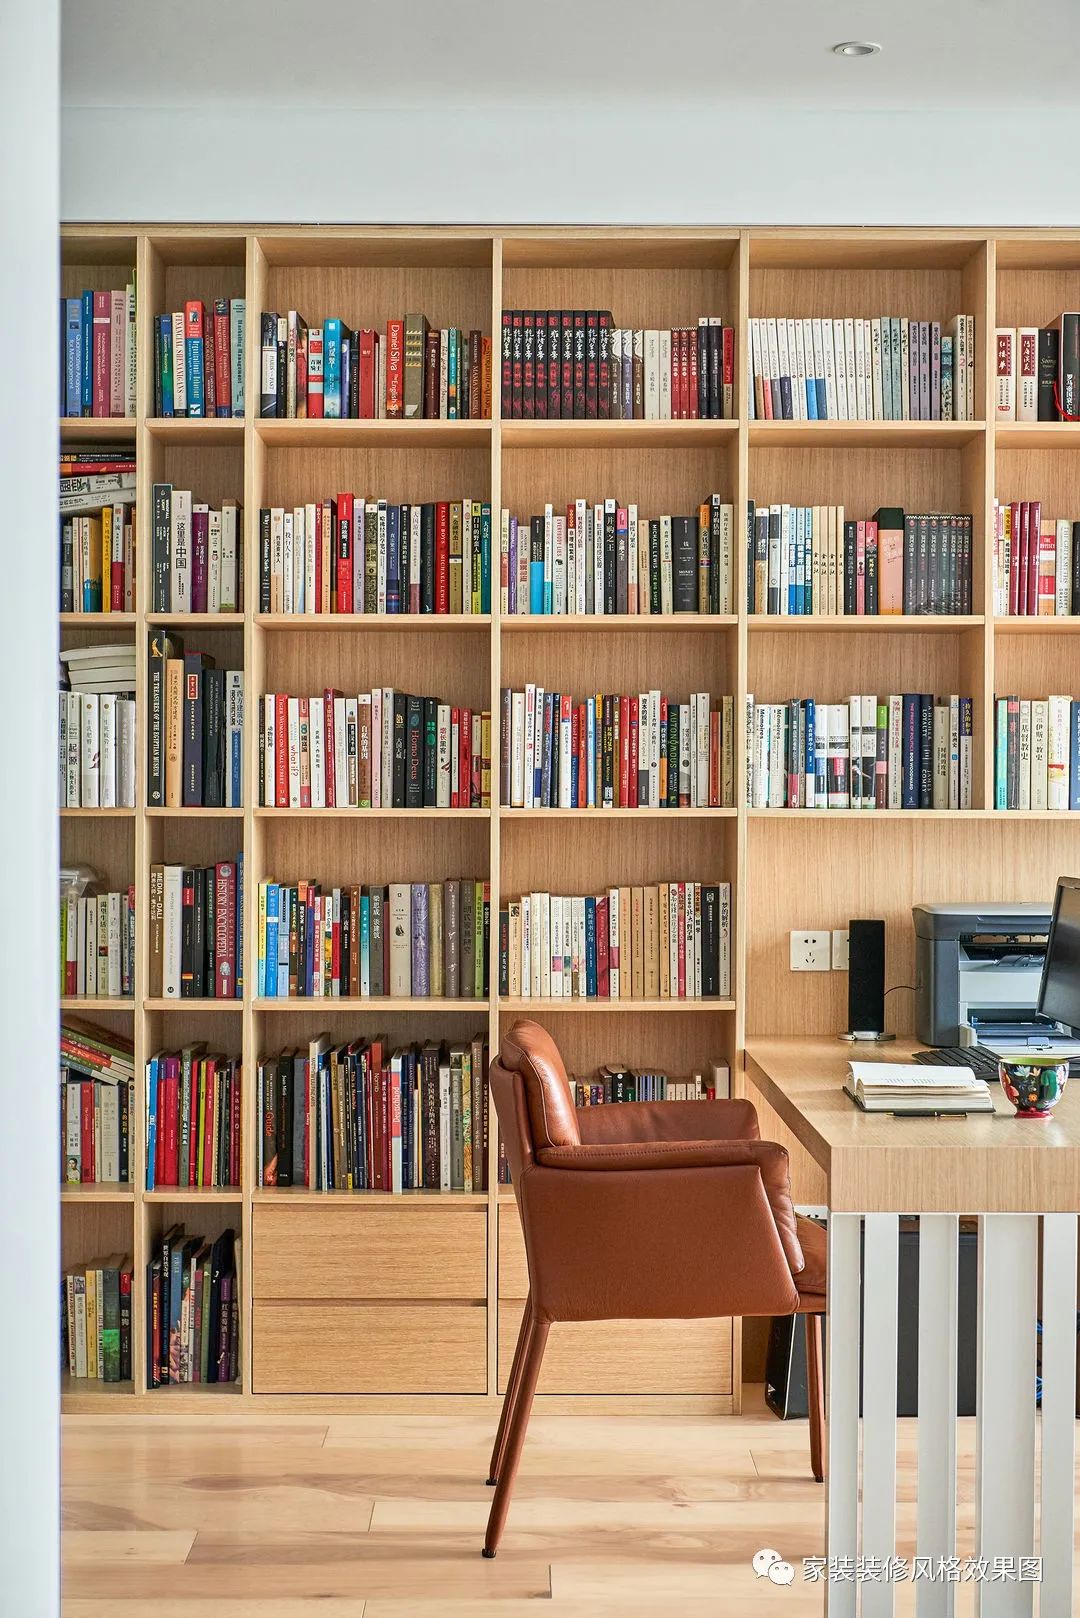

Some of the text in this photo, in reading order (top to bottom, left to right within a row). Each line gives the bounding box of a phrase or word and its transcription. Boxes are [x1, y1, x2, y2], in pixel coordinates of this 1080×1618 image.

[176, 315, 184, 393] FINANCIAL SHENANIGANS
[391, 325, 400, 370] Daniel Silva
[175, 522, 186, 569] 这里是中国
[68, 744, 77, 766] 起源
[279, 739, 284, 748] ON
[291, 766, 299, 777] if?
[217, 879, 227, 957] HISTORY ENCYCLOPEDIA
[392, 1087, 400, 1123] Deutschland
[266, 1112, 274, 1136] Guide
